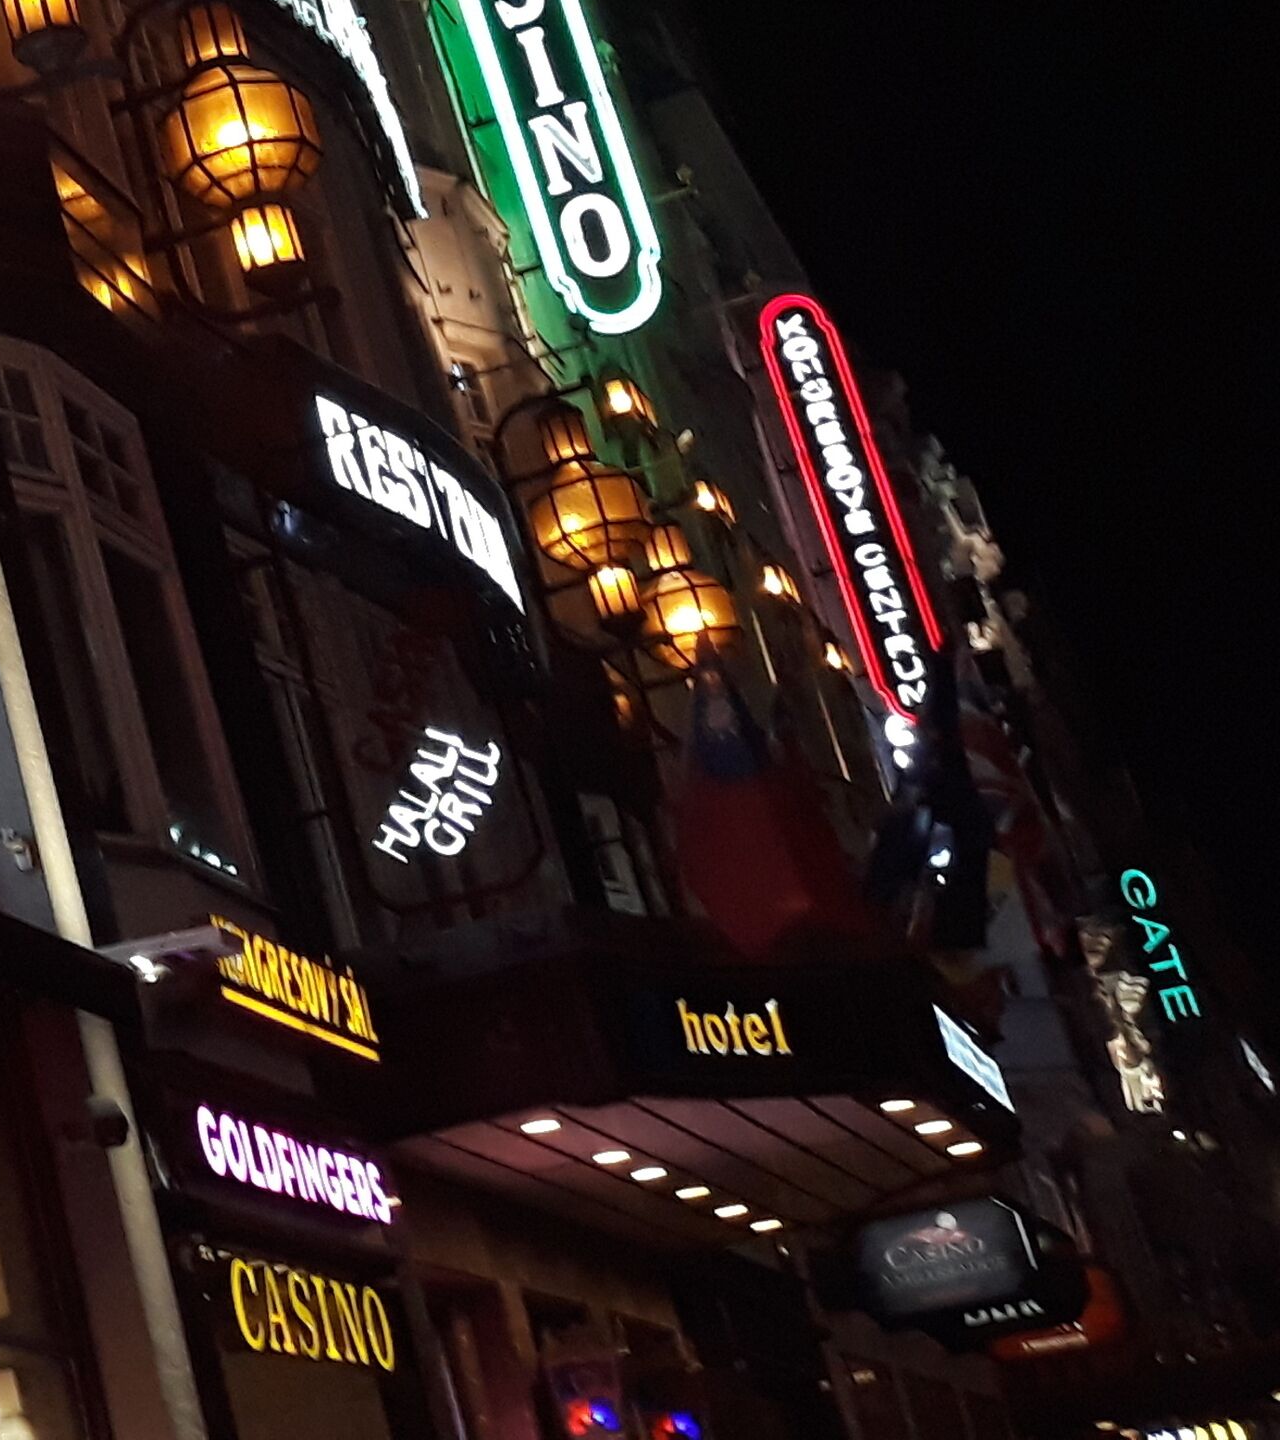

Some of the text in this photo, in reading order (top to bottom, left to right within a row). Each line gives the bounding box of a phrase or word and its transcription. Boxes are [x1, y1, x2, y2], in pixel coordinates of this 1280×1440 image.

[424, 741, 501, 856] GRILL
[1120, 868, 1201, 1023] GATE
[674, 997, 793, 1056] hotel
[196, 1105, 393, 1225] GOLDFINGERS
[229, 1257, 395, 1373] CASINO
